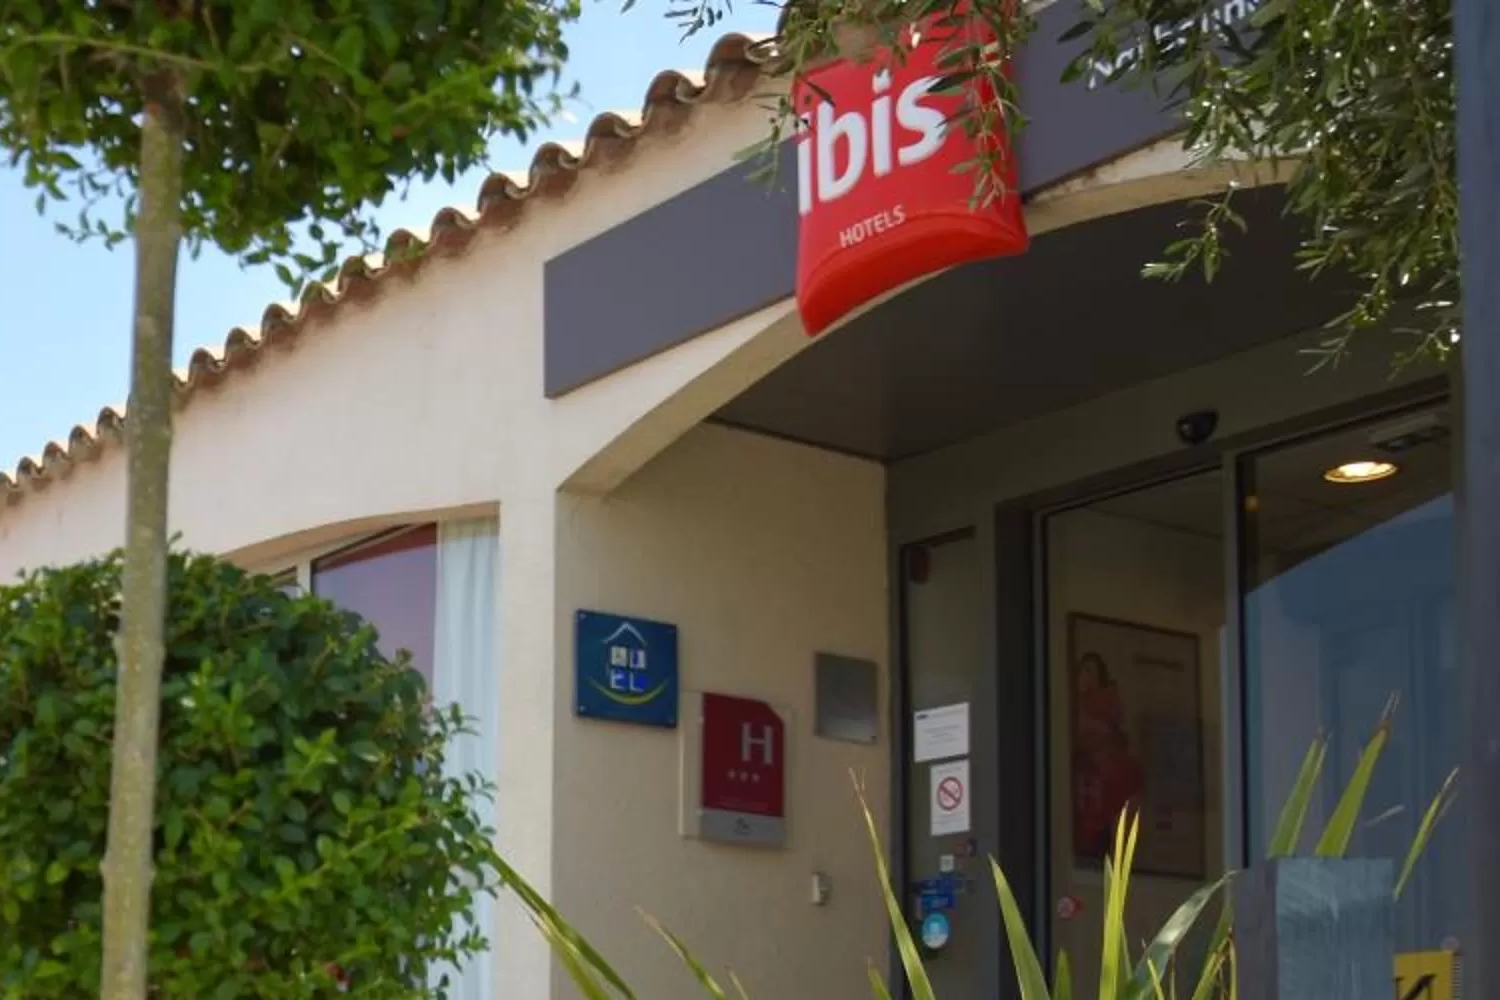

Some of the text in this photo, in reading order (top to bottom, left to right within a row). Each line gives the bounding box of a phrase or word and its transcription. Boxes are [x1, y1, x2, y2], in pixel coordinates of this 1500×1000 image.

[797, 68, 948, 215] ibis
[840, 203, 907, 248] HOTELS
[741, 721, 774, 766] H
